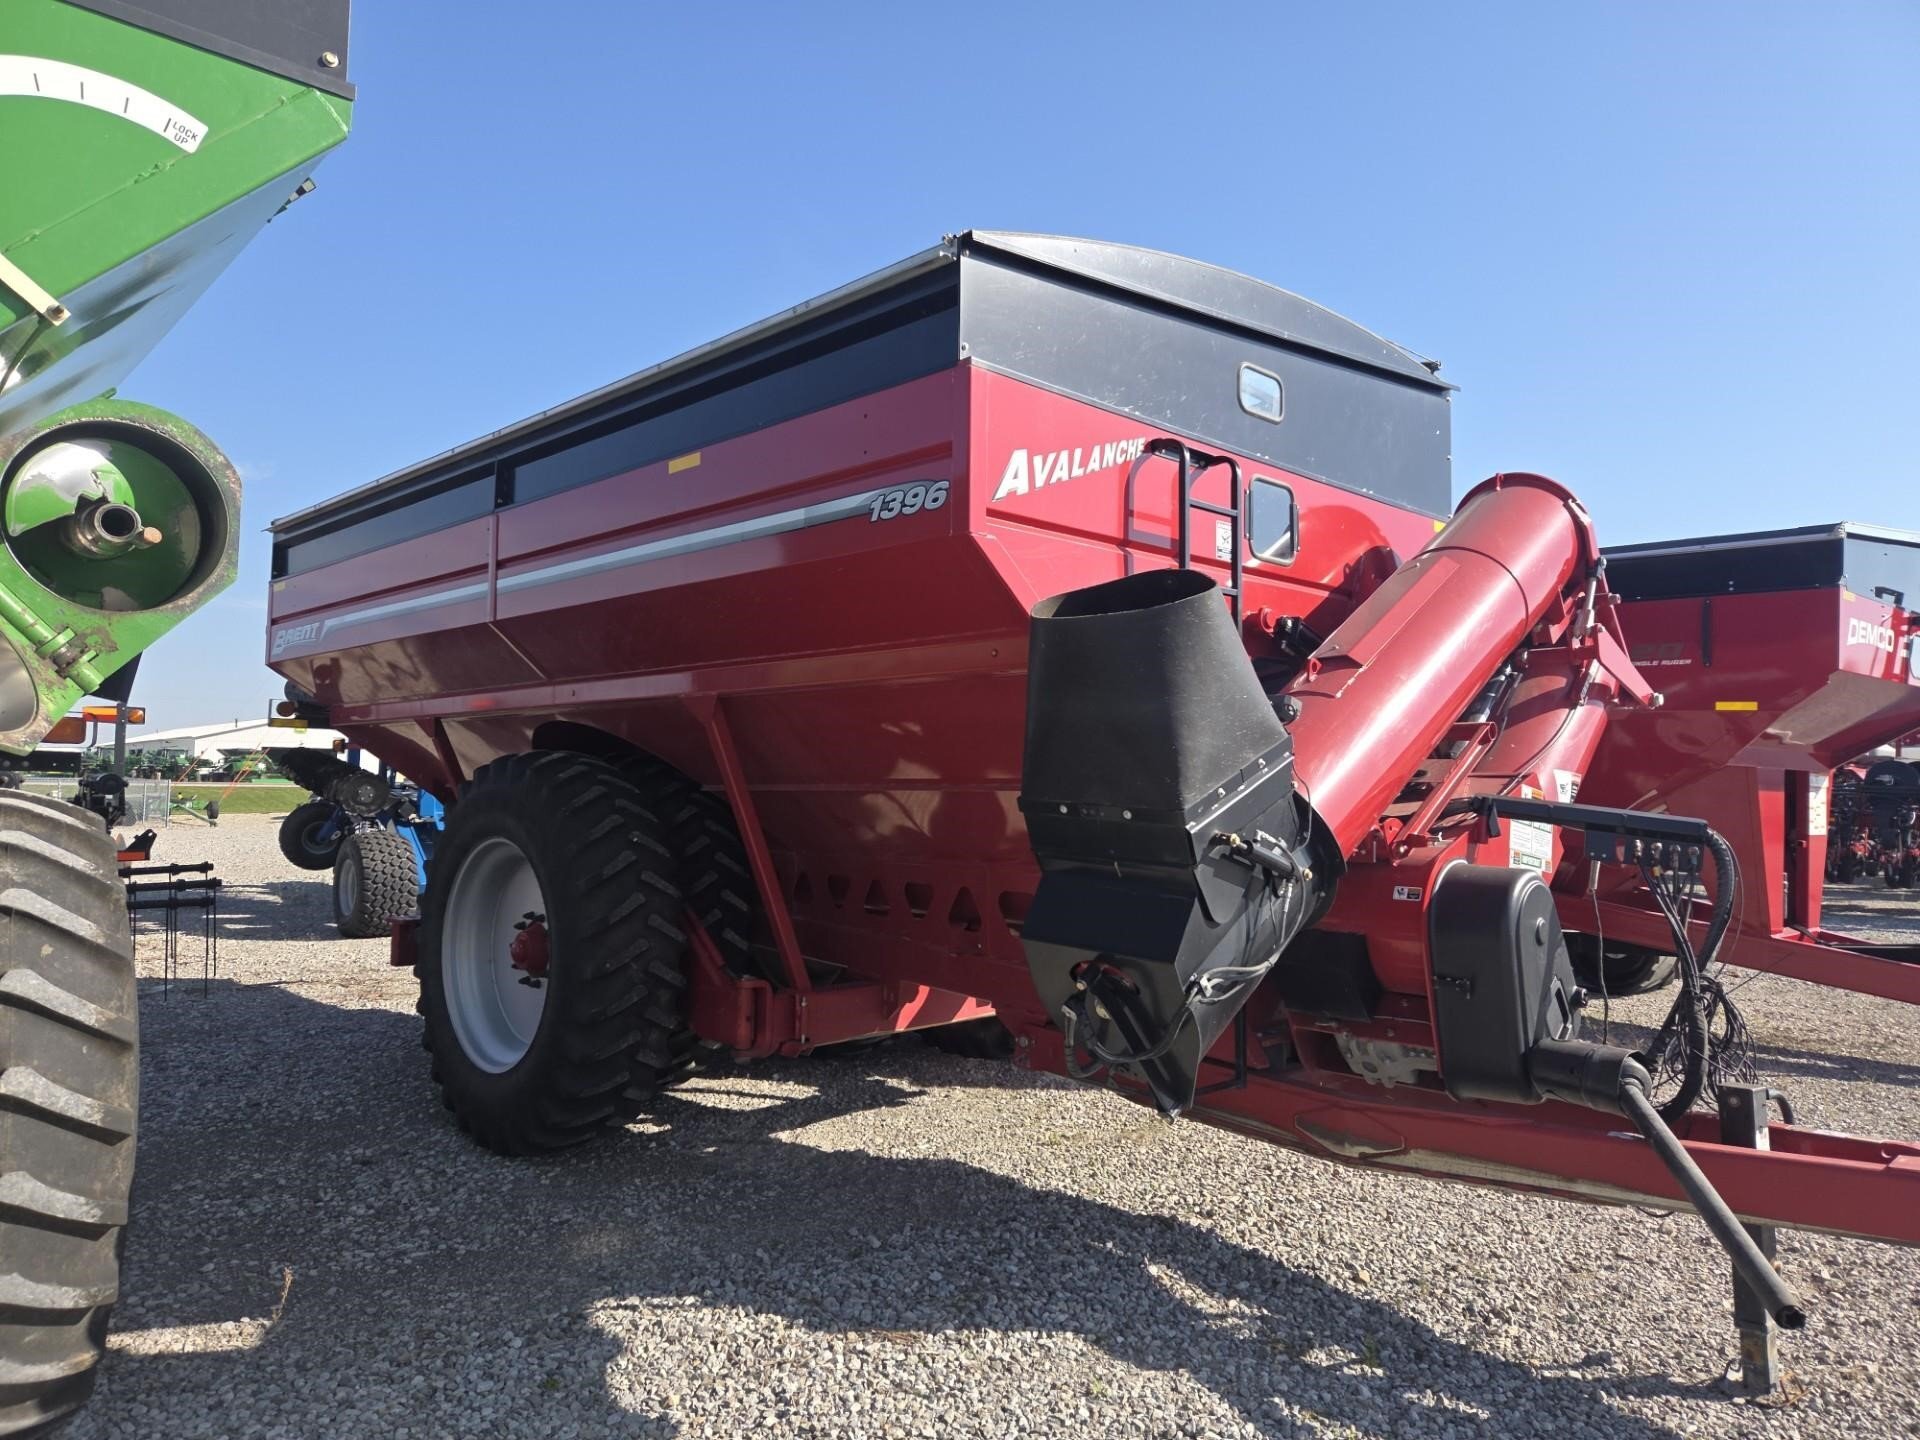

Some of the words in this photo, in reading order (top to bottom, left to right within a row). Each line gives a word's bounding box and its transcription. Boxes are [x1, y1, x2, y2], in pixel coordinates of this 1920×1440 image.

[172, 121, 198, 142] LOCK
[174, 132, 188, 144] UP
[992, 437, 1146, 502] AVALANCHE
[870, 480, 950, 522] 1396
[1847, 617, 1894, 653] DEMCO
